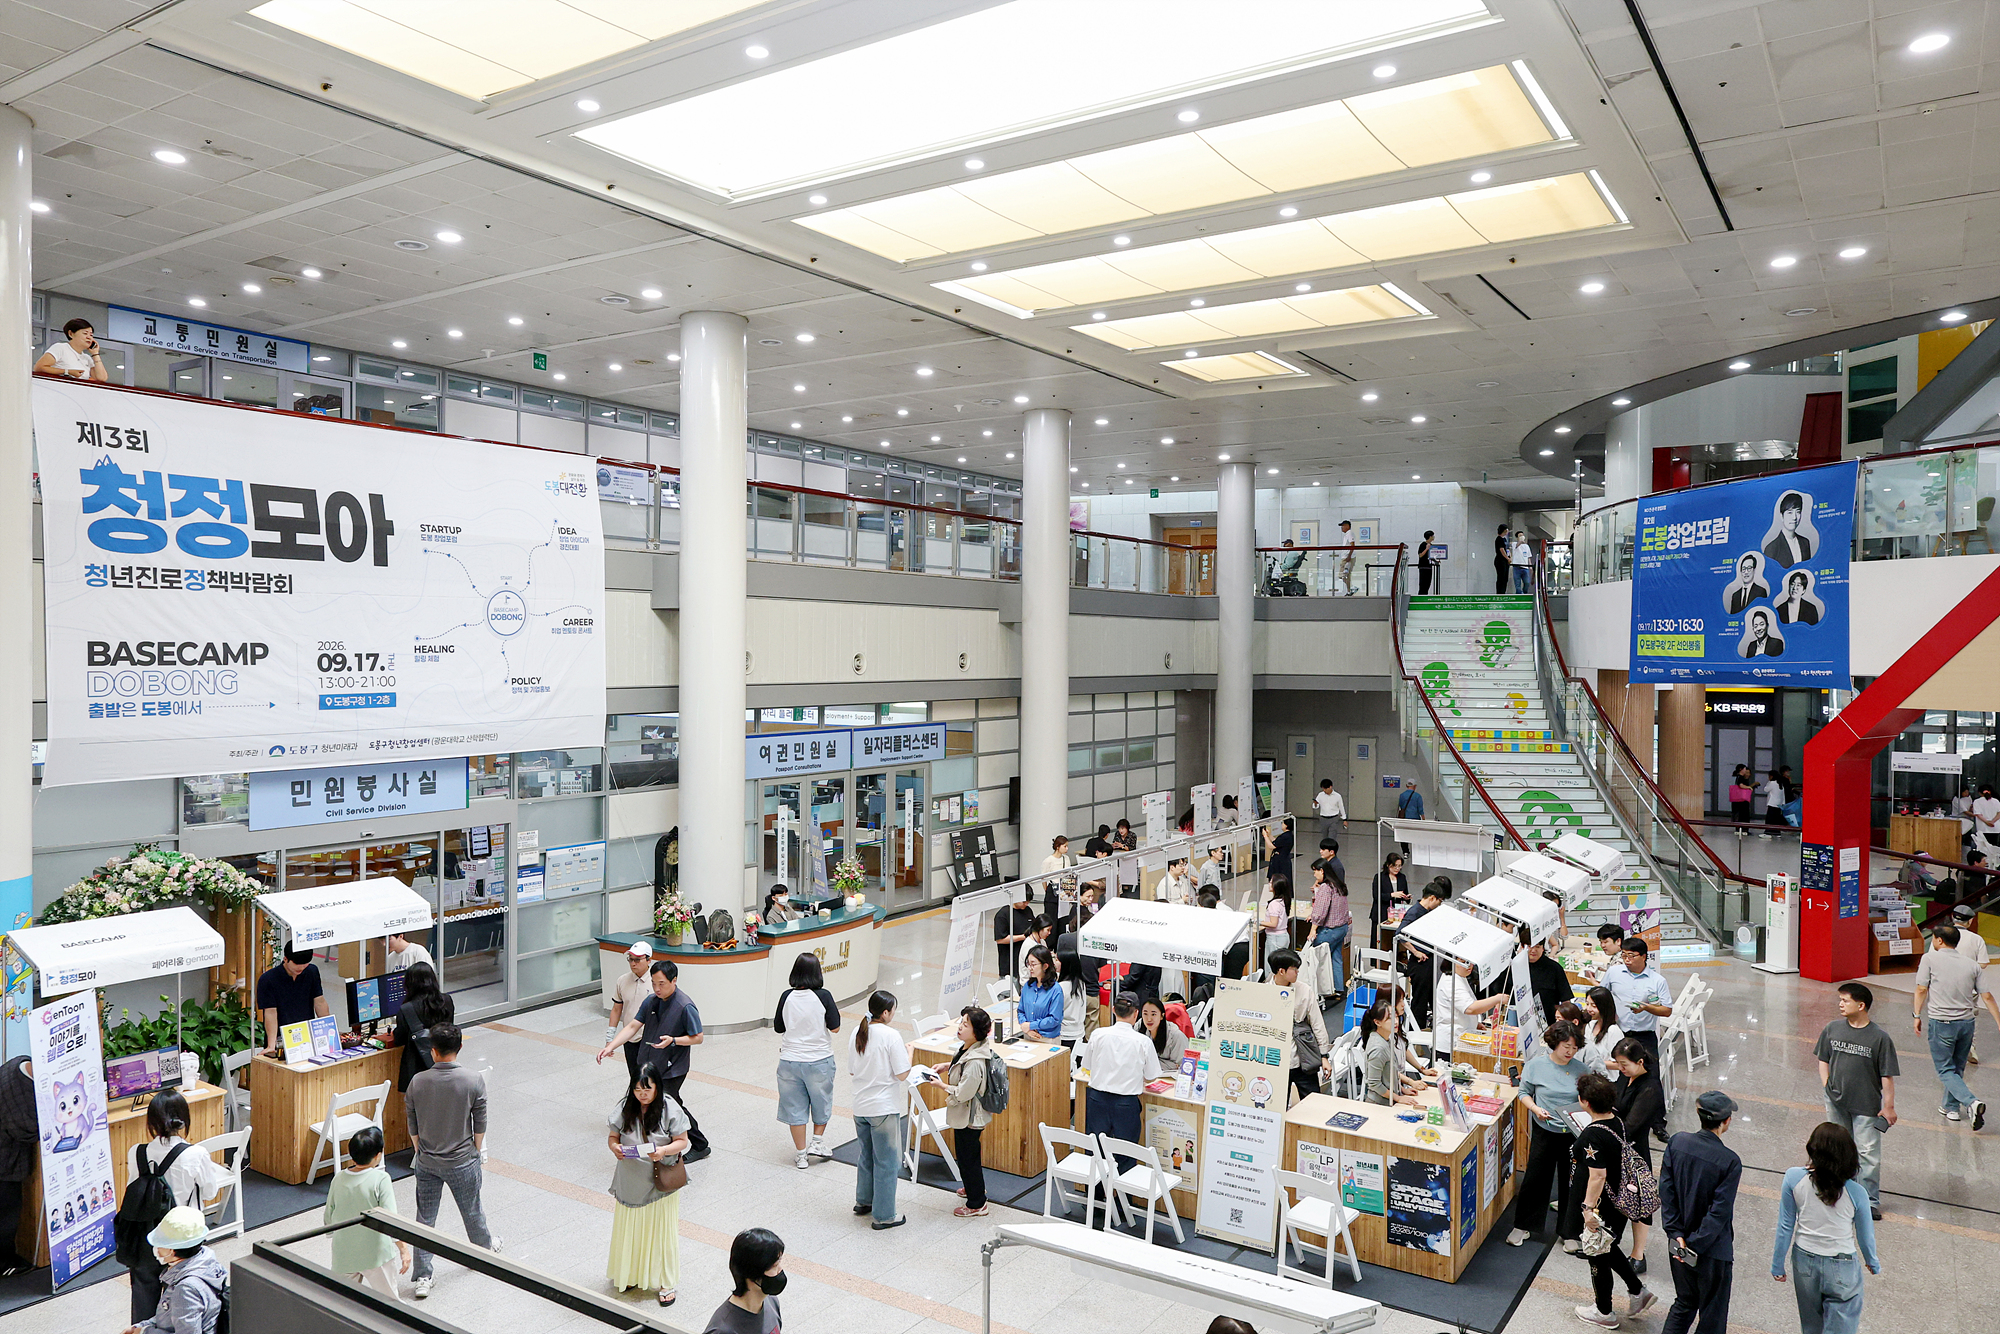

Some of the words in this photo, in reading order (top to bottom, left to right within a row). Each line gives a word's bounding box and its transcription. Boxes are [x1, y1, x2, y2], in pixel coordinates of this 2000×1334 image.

[144, 317, 277, 358] 교통민원실
[142, 336, 164, 346] Office
[166, 340, 174, 348] of
[176, 341, 191, 351] Civil
[193, 344, 218, 357] Service
[232, 352, 277, 366] Transportation
[76, 421, 149, 453] 제3회
[544, 480, 588, 497] 도봉대전환
[79, 454, 394, 567] 청정모아
[420, 524, 462, 534] STARTUP
[557, 527, 577, 535] IDEA
[1641, 516, 1730, 551] 도봉창업포럼
[84, 563, 293, 594] 청년진로정책박람회
[490, 613, 523, 621] DOBONG
[562, 618, 594, 627] CAREER
[1653, 618, 1704, 632] 13:30-16:30
[317, 641, 347, 651] 2026.
[414, 645, 455, 654] HEALING
[1645, 639, 1667, 651] 도봉구청
[1667, 640, 1676, 651] 2F
[87, 641, 269, 667] BASECAMP
[317, 652, 386, 672] 09.17.
[387, 653, 395, 671] THU
[87, 669, 238, 698] DOBONG
[318, 675, 396, 689] 13:00-21:00
[511, 677, 542, 686] POLICY
[334, 695, 365, 707] 도봉구청
[367, 694, 390, 706] 1-2층
[88, 701, 137, 719] 출발은
[141, 700, 203, 717] 도봉에서
[1713, 703, 1766, 714] KB국민은행
[229, 749, 258, 758] 주최/주관
[289, 744, 318, 756] 도봉구
[321, 742, 358, 754] 청년미래과
[759, 739, 837, 764] 여권민원실
[863, 732, 939, 756] 일자리플러스센터
[775, 765, 794, 773] Passport
[290, 769, 437, 808] 민원봉사실
[325, 808, 343, 819] Civil
[346, 806, 375, 817] Service
[378, 802, 407, 813] Division
[302, 900, 352, 911] BASECAMP
[1806, 897, 1812, 910] 1
[383, 917, 408, 928] 노드크루
[408, 915, 428, 924] Poolin
[1118, 916, 1168, 927] BASECAMP
[61, 934, 126, 949] BASECAMP
[305, 930, 334, 942] 청정모아
[1091, 940, 1118, 953] 청정모아
[151, 956, 184, 970] 페어리움
[185, 952, 219, 966] gentoon
[1162, 951, 1182, 963] 도봉구
[1183, 954, 1217, 968] 청년미래과
[59, 970, 97, 985] 청정모아
[41, 1002, 85, 1025] GenToon
[49, 1023, 81, 1048] 이야기를
[46, 1033, 87, 1063] 웹툰으로!
[1219, 1039, 1281, 1067] 청년새롬
[1300, 1143, 1321, 1154] OPCD
[1309, 1163, 1321, 1172] 음악
[1319, 1155, 1334, 1166] LP
[1311, 1171, 1328, 1180] 감상실
[1390, 1182, 1433, 1198] OPCD
[1390, 1191, 1445, 1209] STAGE
